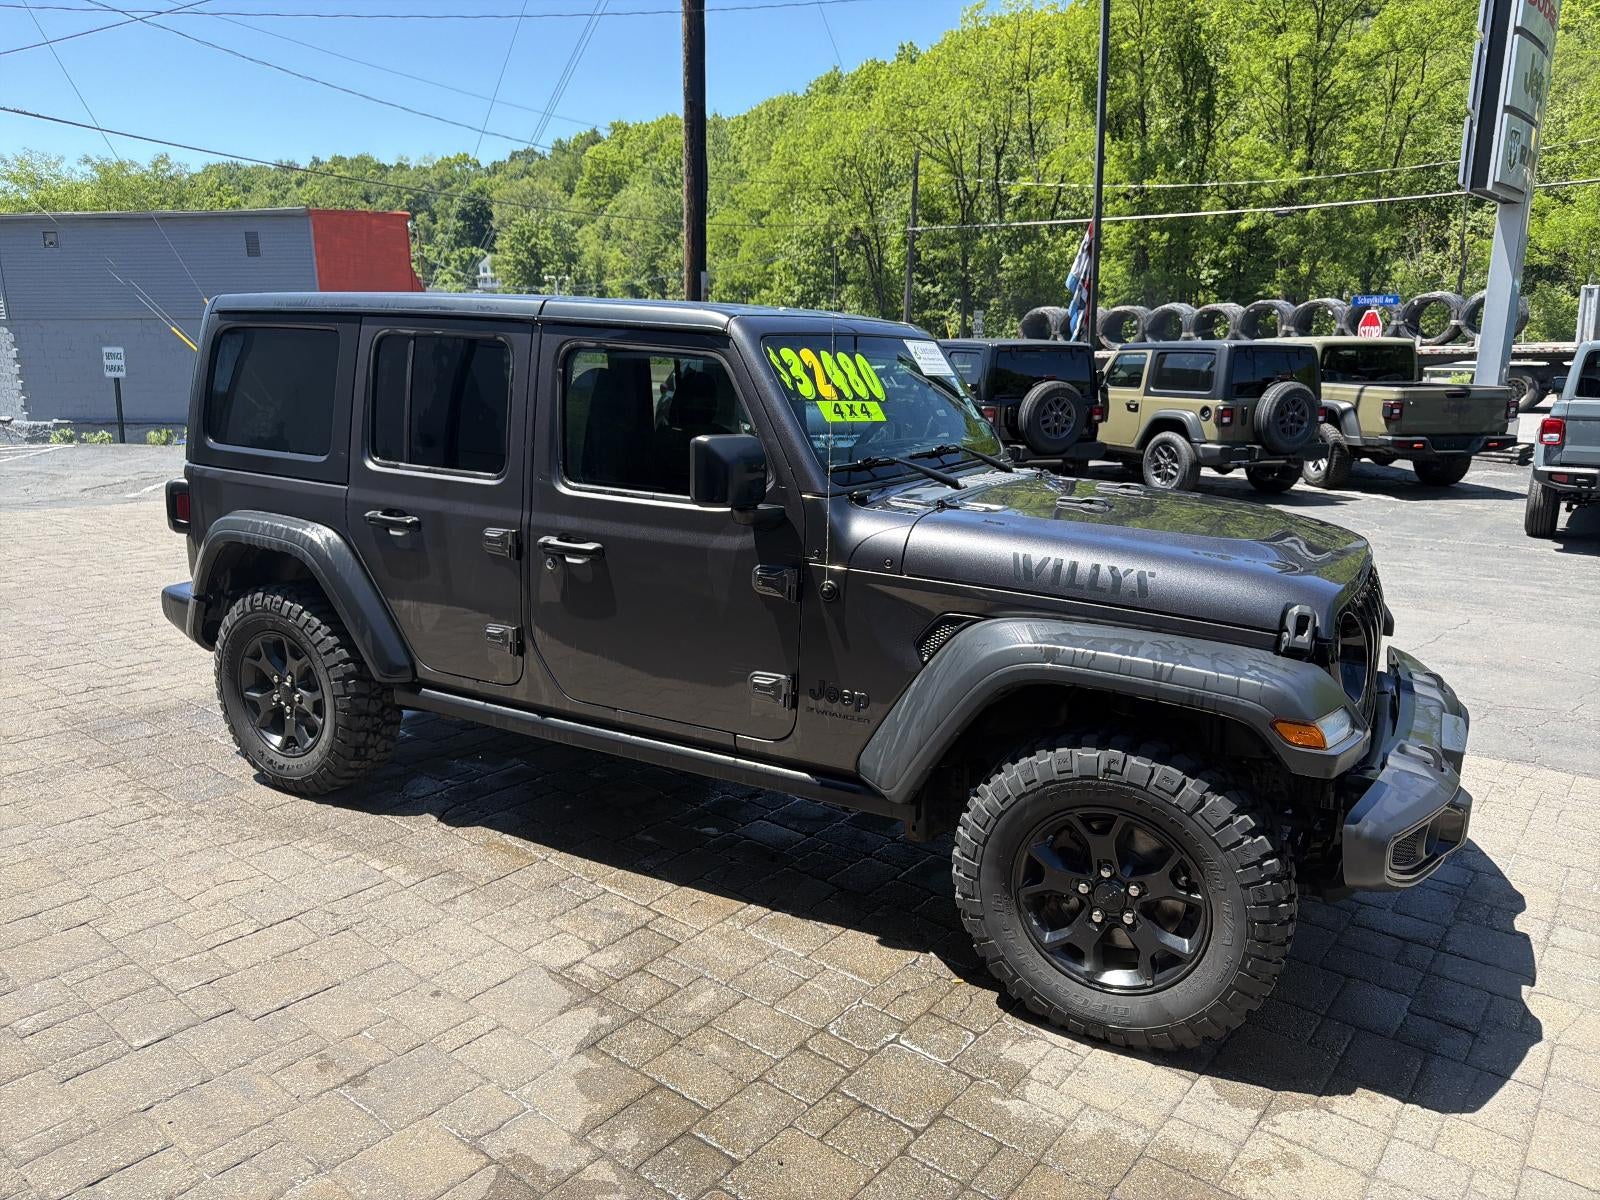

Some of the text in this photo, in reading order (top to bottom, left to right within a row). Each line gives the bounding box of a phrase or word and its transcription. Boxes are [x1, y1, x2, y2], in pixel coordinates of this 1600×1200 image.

[1358, 296, 1394, 304] Schuylkill Ave
[1361, 326, 1380, 338] STOP
[105, 352, 122, 360] SERVICE
[767, 346, 886, 401] $32480
[809, 679, 870, 712] Jeep
